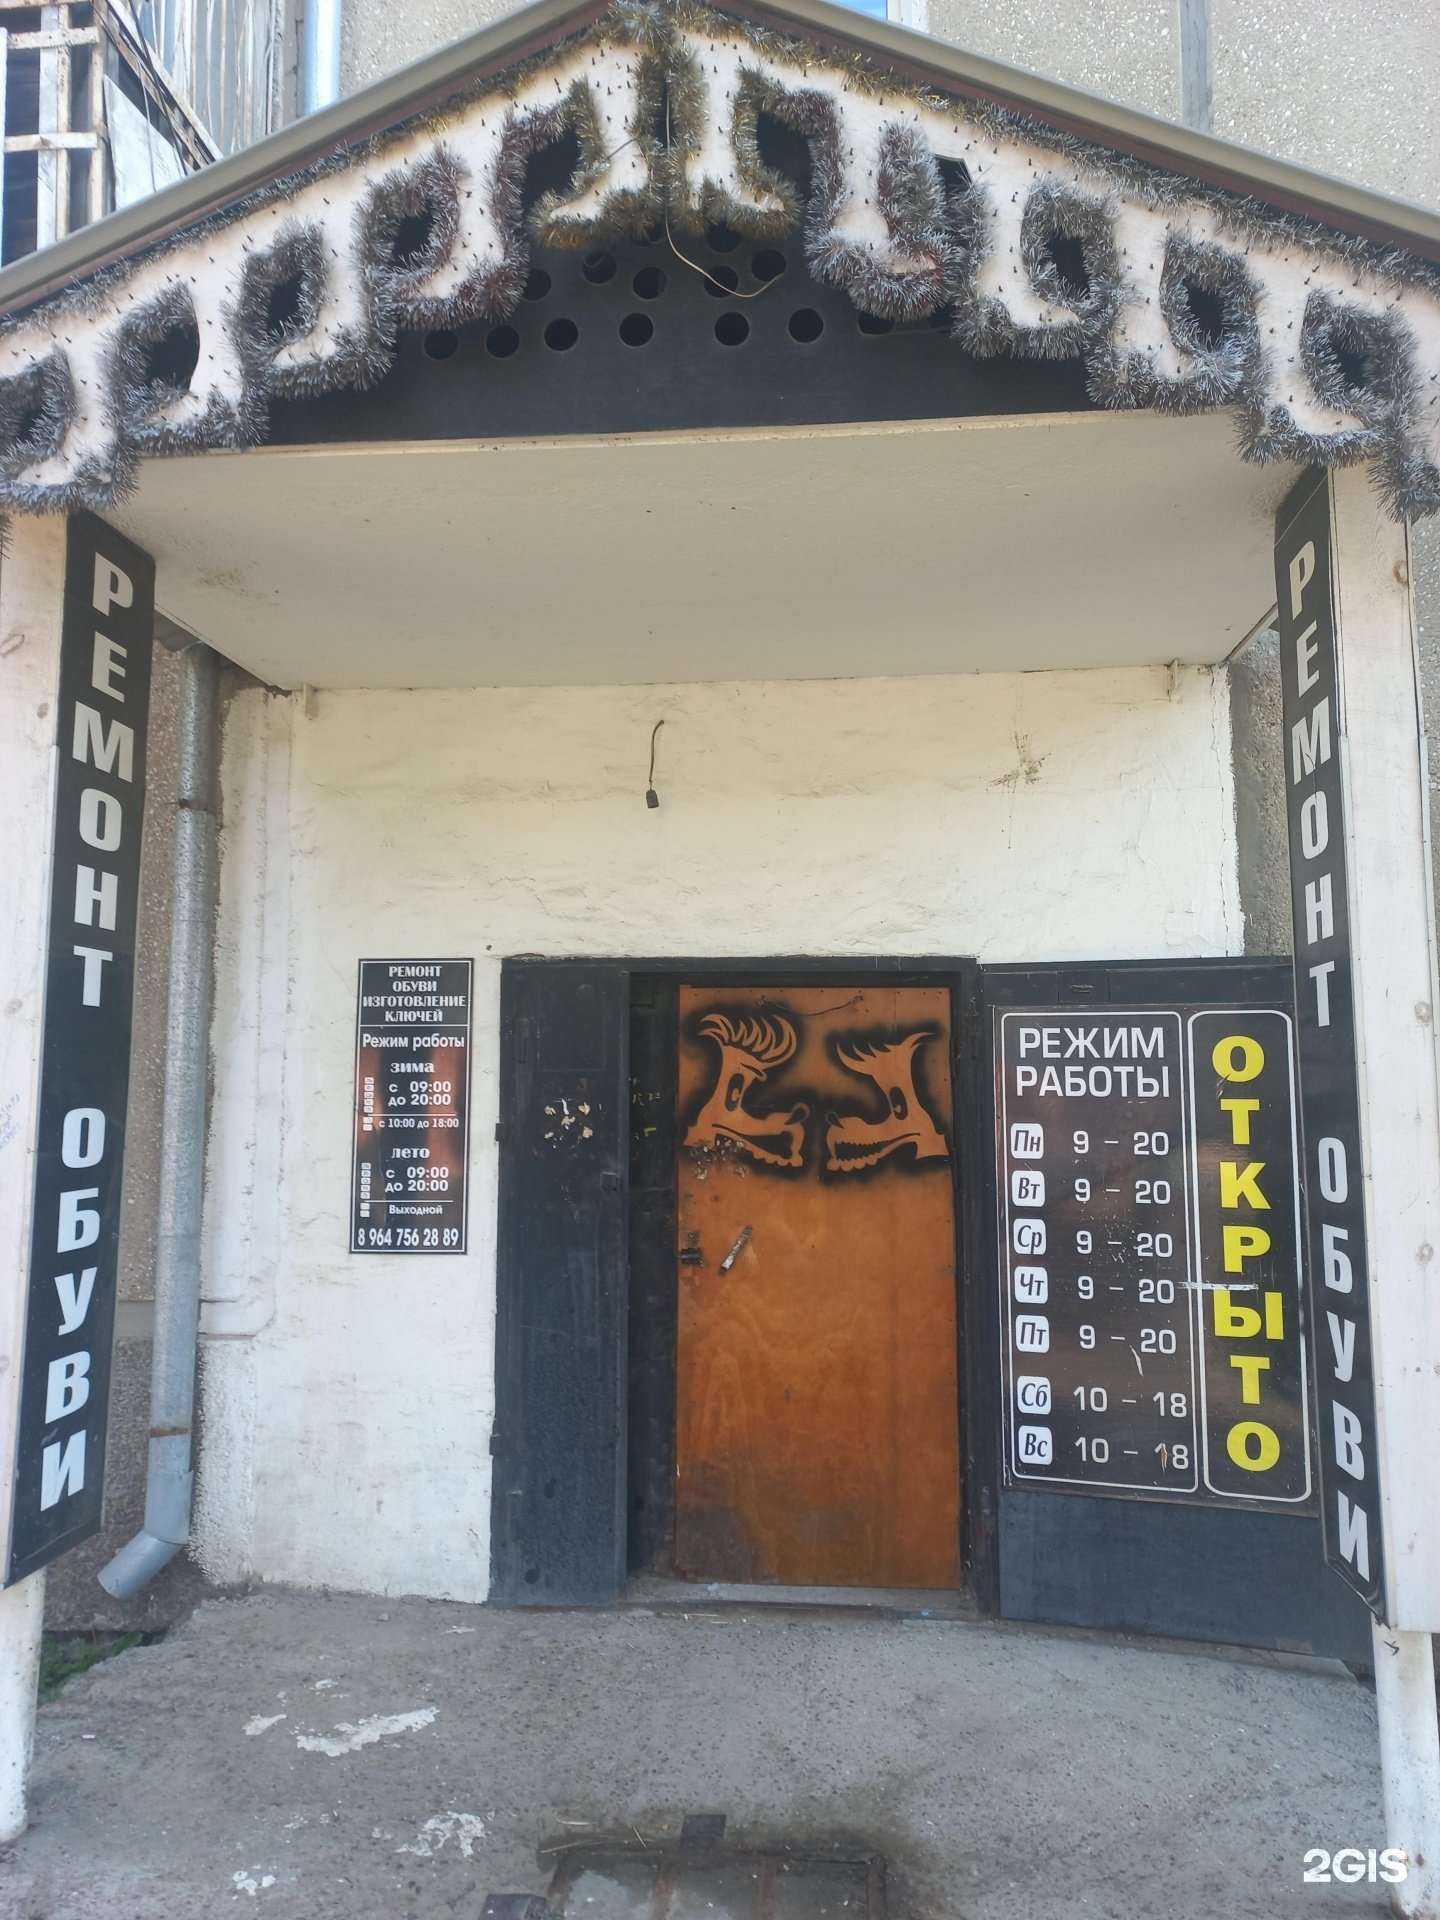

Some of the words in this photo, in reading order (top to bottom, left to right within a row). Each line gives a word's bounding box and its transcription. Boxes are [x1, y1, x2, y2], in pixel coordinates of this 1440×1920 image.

[72, 551, 135, 1008] РЕМОНТ
[388, 965, 442, 978] РЕМОНТ
[392, 980, 437, 992] ОБУВИ
[362, 995, 467, 1007] ИЗГОТОВЛЕНИЕ
[384, 1009, 443, 1022] КЛЮЧЕЙ
[362, 1033, 409, 1048] Режим
[412, 1032, 465, 1052] работы
[1019, 1027, 1165, 1059] РЕЖИМ
[390, 1062, 435, 1073] зима
[1289, 540, 1335, 1028] РЕМОНТ
[1317, 1136, 1371, 1583] ОБУВИ
[409, 1081, 452, 1093] 09:00
[1015, 1065, 1170, 1098] РАБОТЫ
[410, 1094, 452, 1106] 20:00
[387, 1118, 416, 1128] 10:00
[432, 1118, 460, 1128] 18:00
[1014, 1129, 1042, 1152] Пн
[1073, 1130, 1090, 1154] 9
[1133, 1131, 1170, 1156] 20
[391, 1147, 431, 1159] лето
[406, 1166, 449, 1179] 09:00
[407, 1179, 449, 1192] 20:00
[1017, 1177, 1041, 1201] Вт
[1074, 1178, 1091, 1202] 9
[1135, 1180, 1172, 1205] 20
[388, 1204, 443, 1216] Выходной
[357, 1228, 366, 1246] 8
[368, 1228, 393, 1246] 964
[396, 1228, 420, 1246] 756
[423, 1228, 439, 1246] 28
[442, 1228, 459, 1246] 89
[1017, 1224, 1042, 1253] Ср
[1076, 1230, 1093, 1254] 9
[1136, 1232, 1174, 1258] 20
[1211, 1035, 1285, 1473] ОТКРЫТО
[1019, 1272, 1045, 1297] Чт
[1077, 1275, 1095, 1300] 9
[1138, 1278, 1176, 1304] 20
[39, 1107, 106, 1513] ОБУВИ
[1019, 1322, 1047, 1346] Пт
[1079, 1324, 1096, 1350] 9
[1140, 1328, 1177, 1355] 20
[1021, 1383, 1048, 1408] Сб
[1073, 1386, 1108, 1412] 10
[1152, 1391, 1188, 1418] 18
[1024, 1433, 1048, 1458] Вс
[1074, 1437, 1109, 1463] 10
